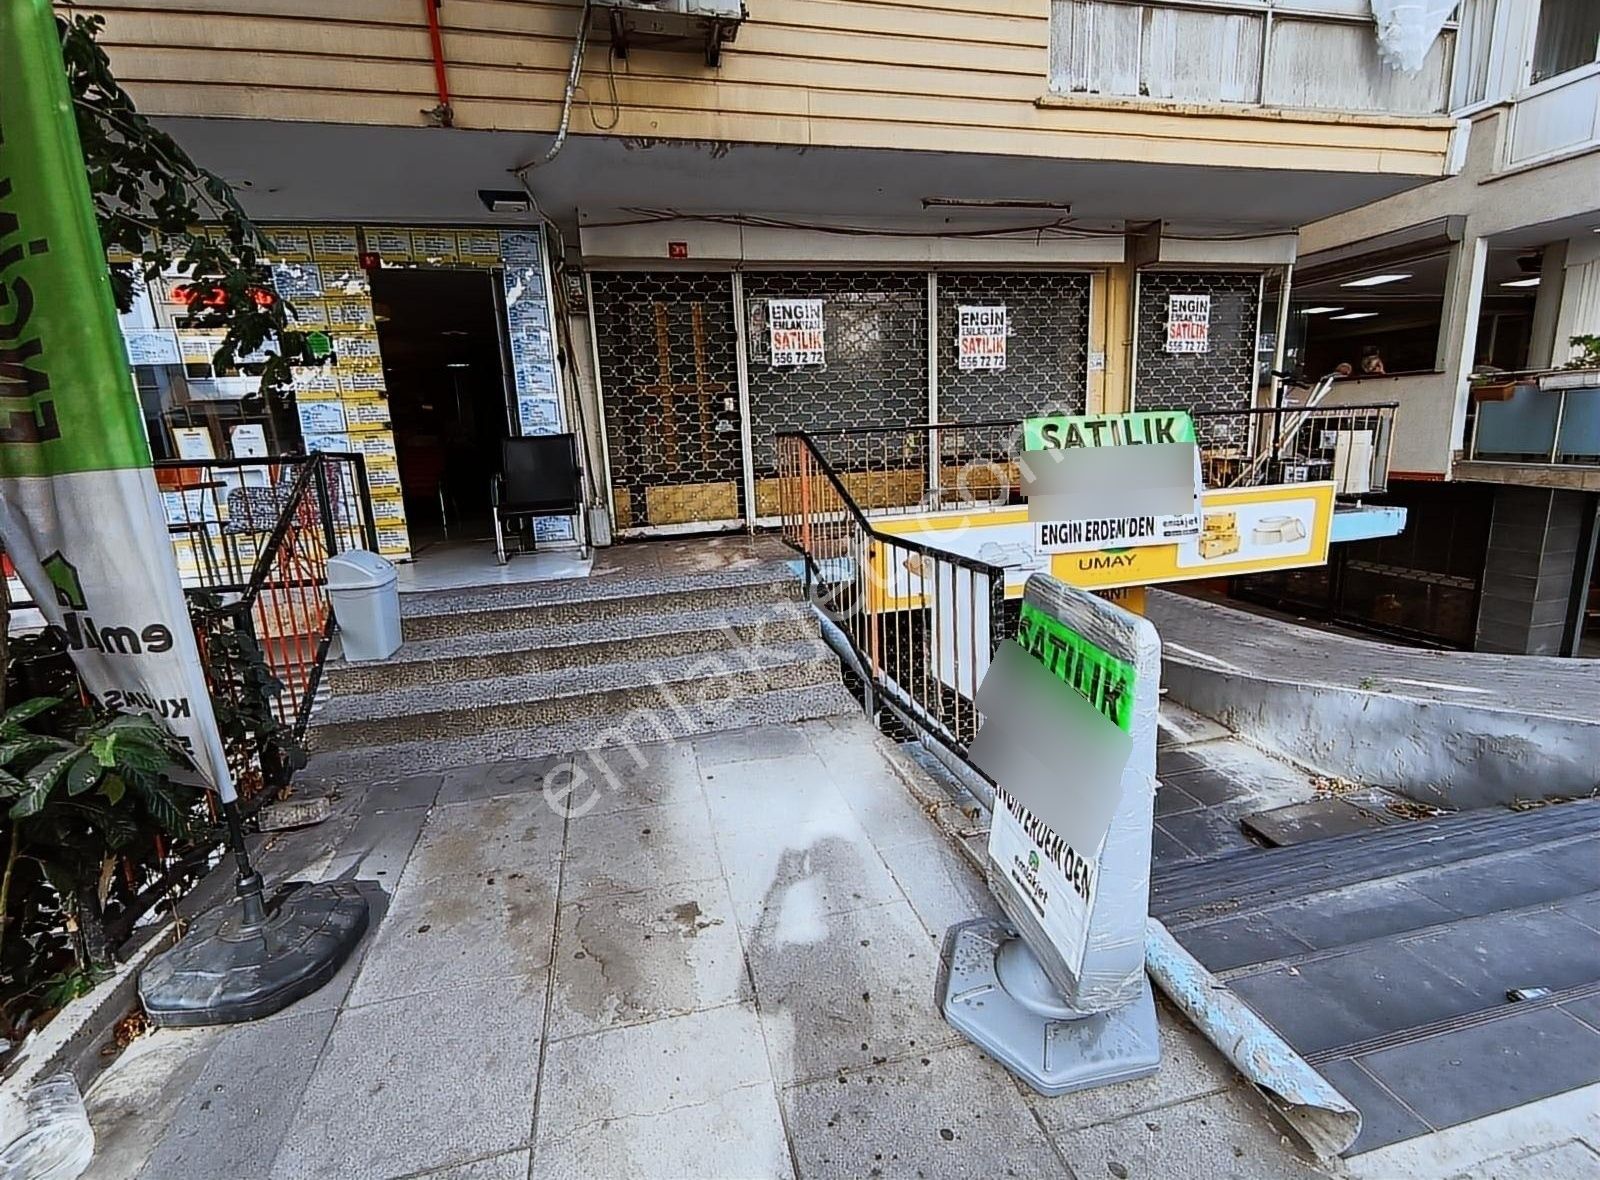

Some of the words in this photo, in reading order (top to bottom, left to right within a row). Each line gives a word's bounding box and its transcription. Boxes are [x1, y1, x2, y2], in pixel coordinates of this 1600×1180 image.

[961, 309, 1003, 326] ENGİN
[1170, 323, 1205, 339] SATILIK
[774, 331, 821, 349] SATILIK
[962, 337, 1003, 354] SATILIK
[774, 353, 792, 363] 556
[796, 352, 808, 362] 72
[811, 352, 822, 361] 72
[1041, 417, 1176, 450] SATILIK
[1041, 519, 1082, 546] ENGİN
[1085, 516, 1154, 543] ERDEM'DEN
[1079, 554, 1137, 571] UMAY
